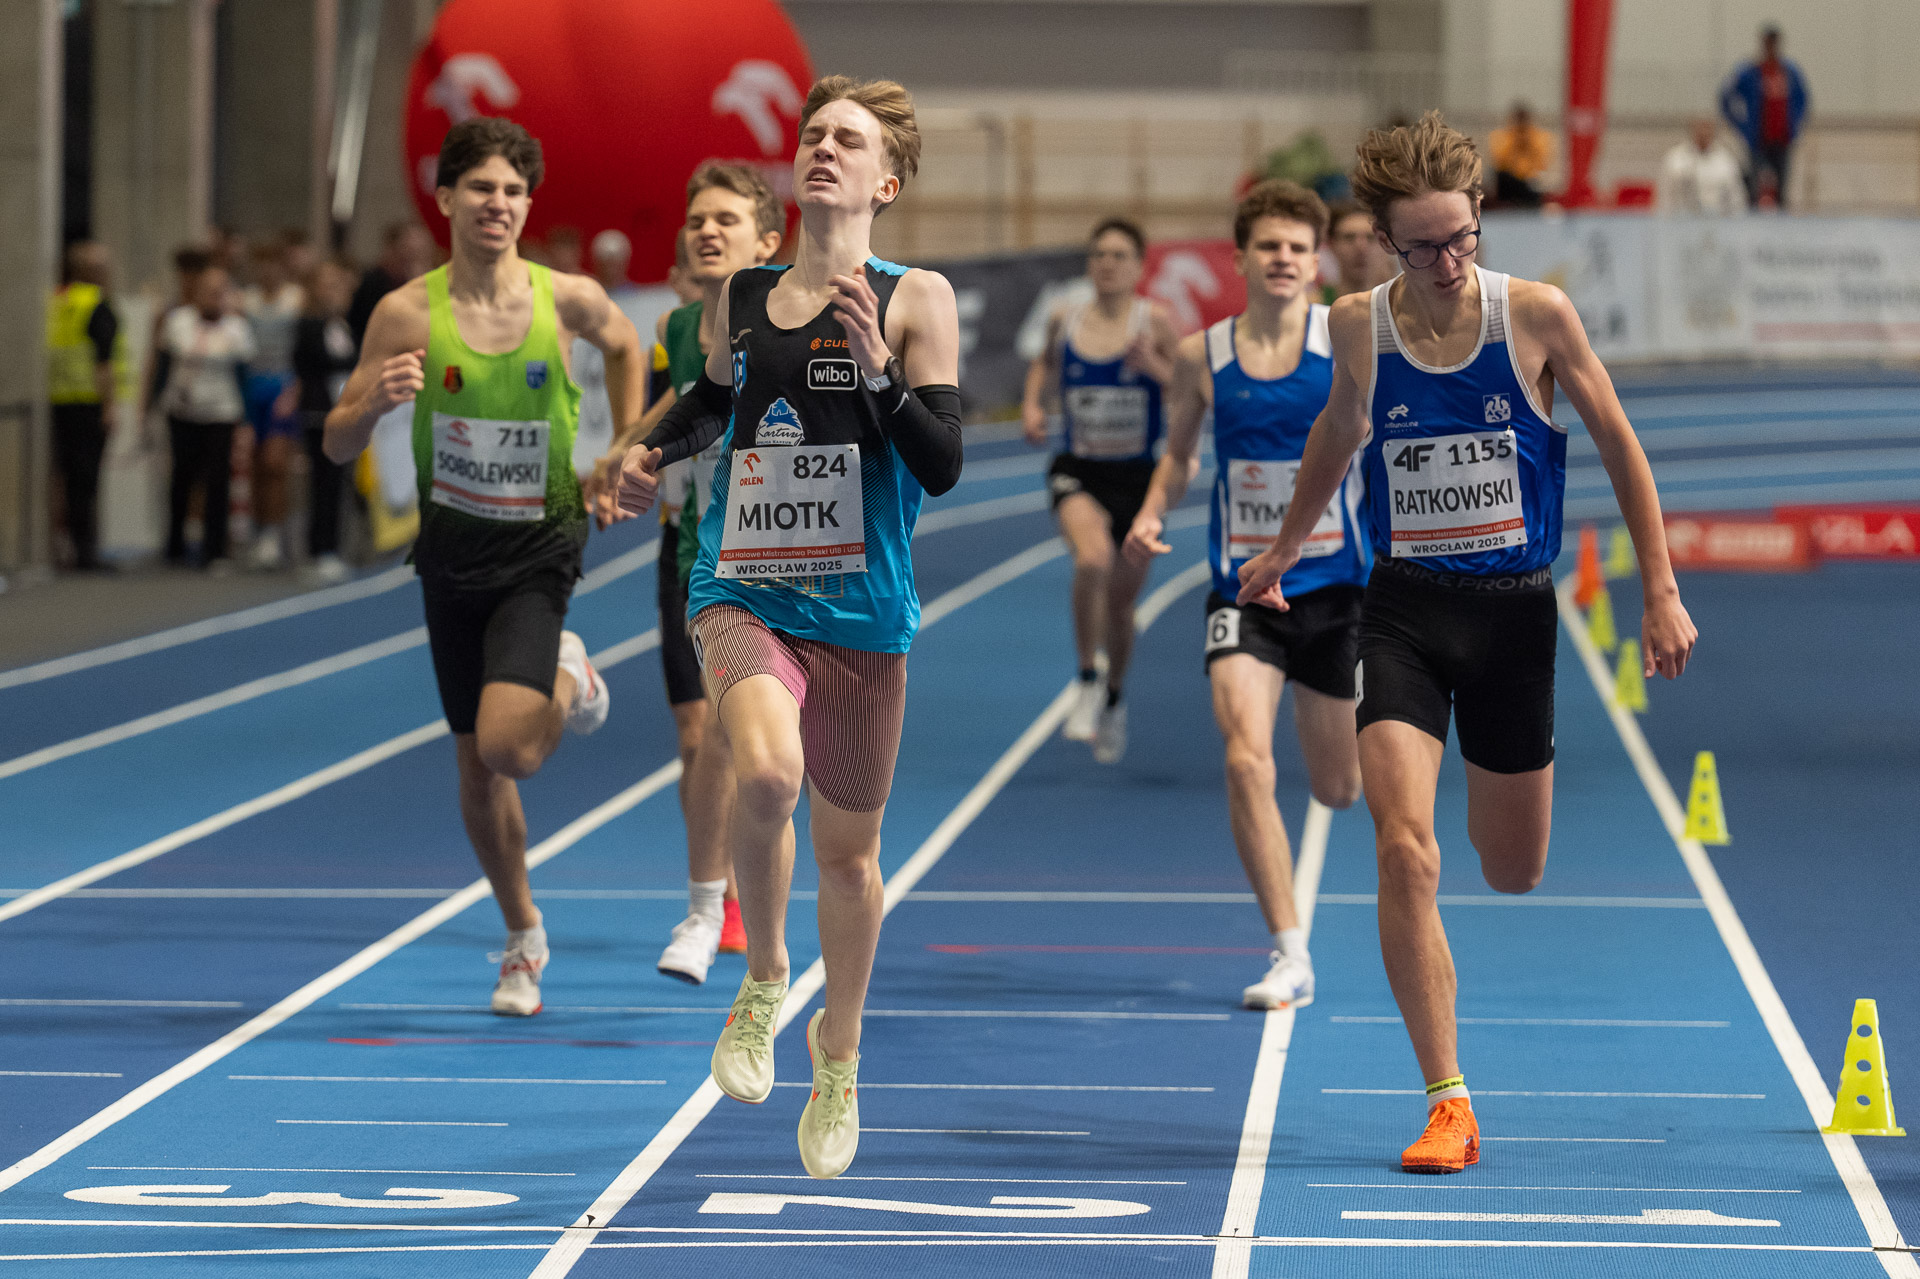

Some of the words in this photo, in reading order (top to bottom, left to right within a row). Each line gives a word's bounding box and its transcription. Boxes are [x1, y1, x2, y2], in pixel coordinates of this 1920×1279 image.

[813, 365, 850, 383] wibo
[498, 428, 539, 448] 711
[1393, 443, 1436, 472] 4F
[1447, 439, 1512, 466] 1155
[437, 450, 541, 484] SOBOLEWSKI
[793, 453, 848, 480] 824
[739, 476, 764, 487] ORLEN
[1394, 478, 1514, 515] RATKOWSKI
[738, 500, 840, 532] MIOTK
[1433, 529, 1472, 538] Mistrzostwa
[1473, 525, 1493, 535] Polski
[1508, 520, 1521, 528] U20
[735, 551, 761, 559] Halowe
[762, 548, 806, 557] Mistrzostwa
[807, 546, 828, 555] Polski
[847, 545, 861, 553] U20
[1411, 541, 1475, 554] WROCŁAW
[1477, 535, 1507, 549] 2025
[735, 562, 808, 575] WROCŁAW
[810, 560, 843, 572] 2025
[1457, 577, 1516, 591] PRO
[1212, 614, 1228, 643] 6
[64, 1184, 520, 1209] 3
[698, 1192, 1152, 1219] 2
